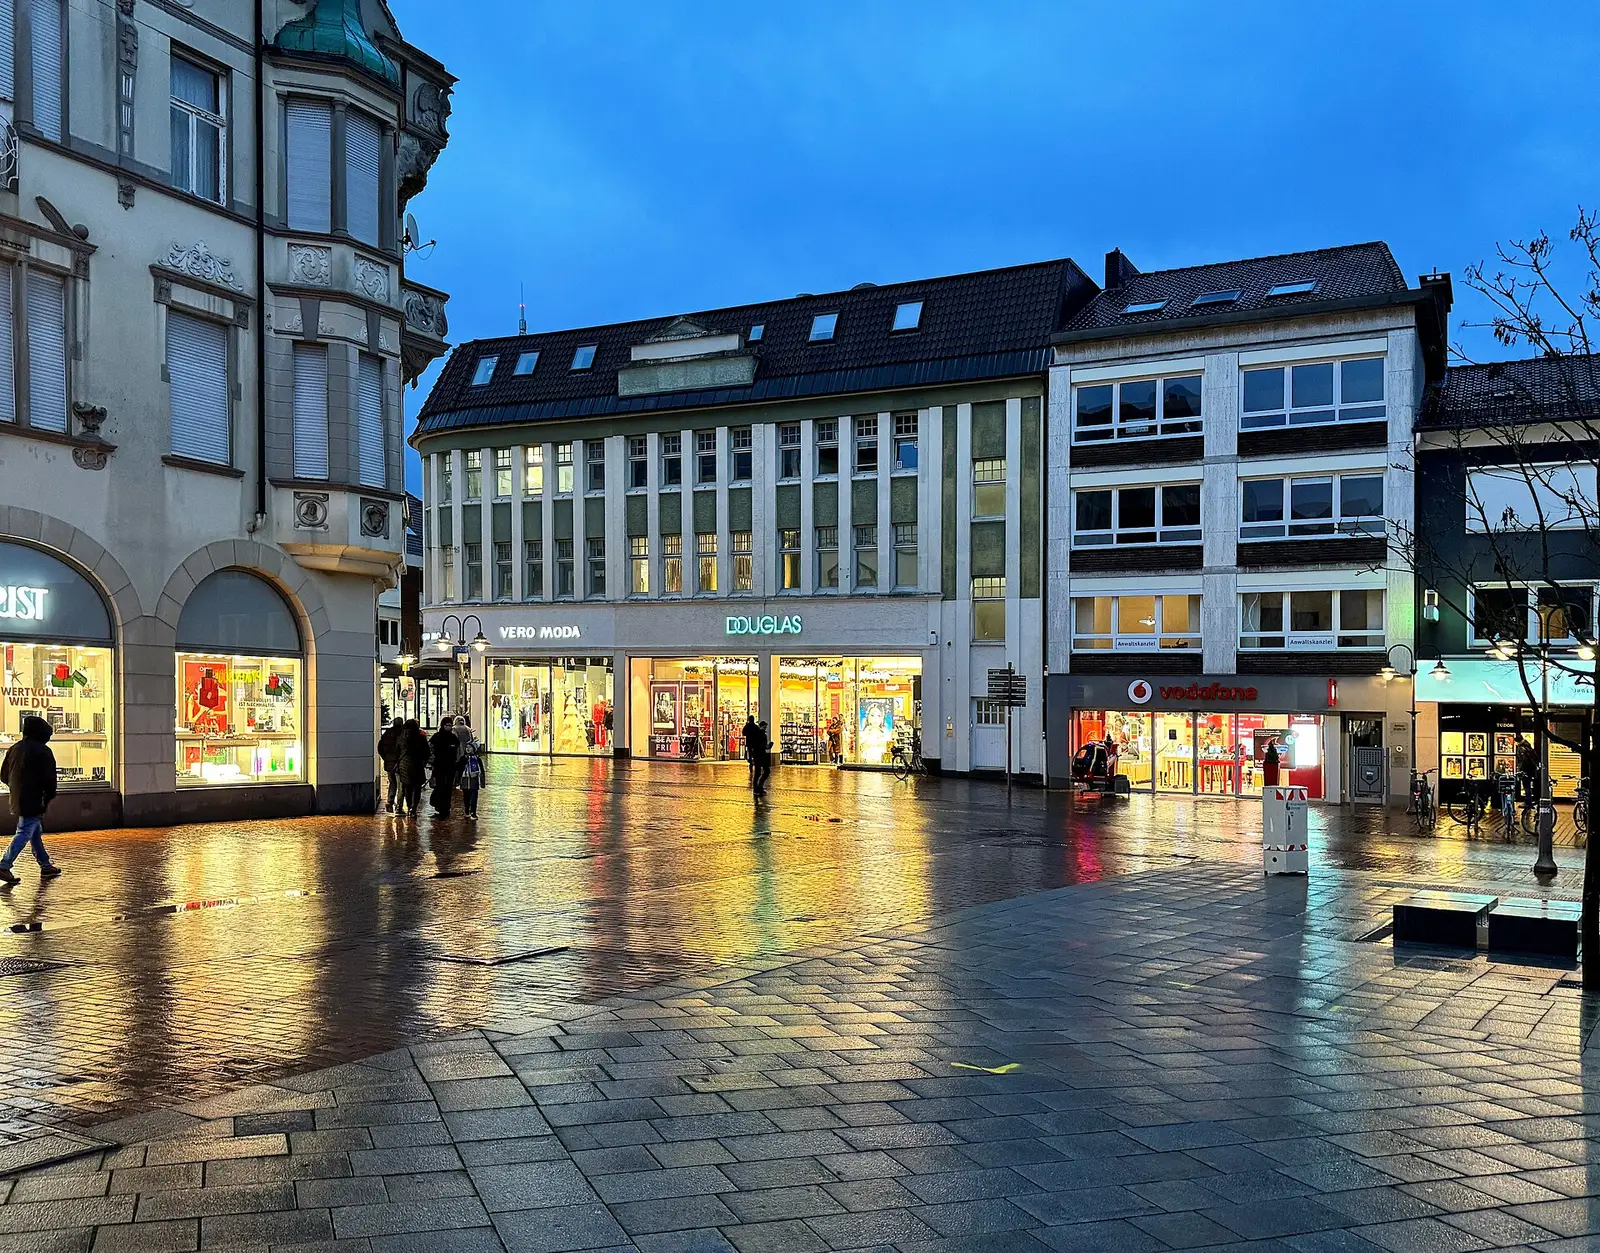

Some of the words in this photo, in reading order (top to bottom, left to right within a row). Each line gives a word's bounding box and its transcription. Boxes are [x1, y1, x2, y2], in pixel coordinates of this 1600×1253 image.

[726, 615, 802, 635] DOUGLAS
[500, 627, 536, 639] VERO
[540, 625, 581, 639] MODA
[1289, 637, 1333, 646] Anwaltskanzlei
[1, 686, 57, 697] WERTVOLL
[1159, 682, 1258, 701] vodafone
[9, 697, 29, 706] WIE
[655, 741, 686, 750] FRIY
